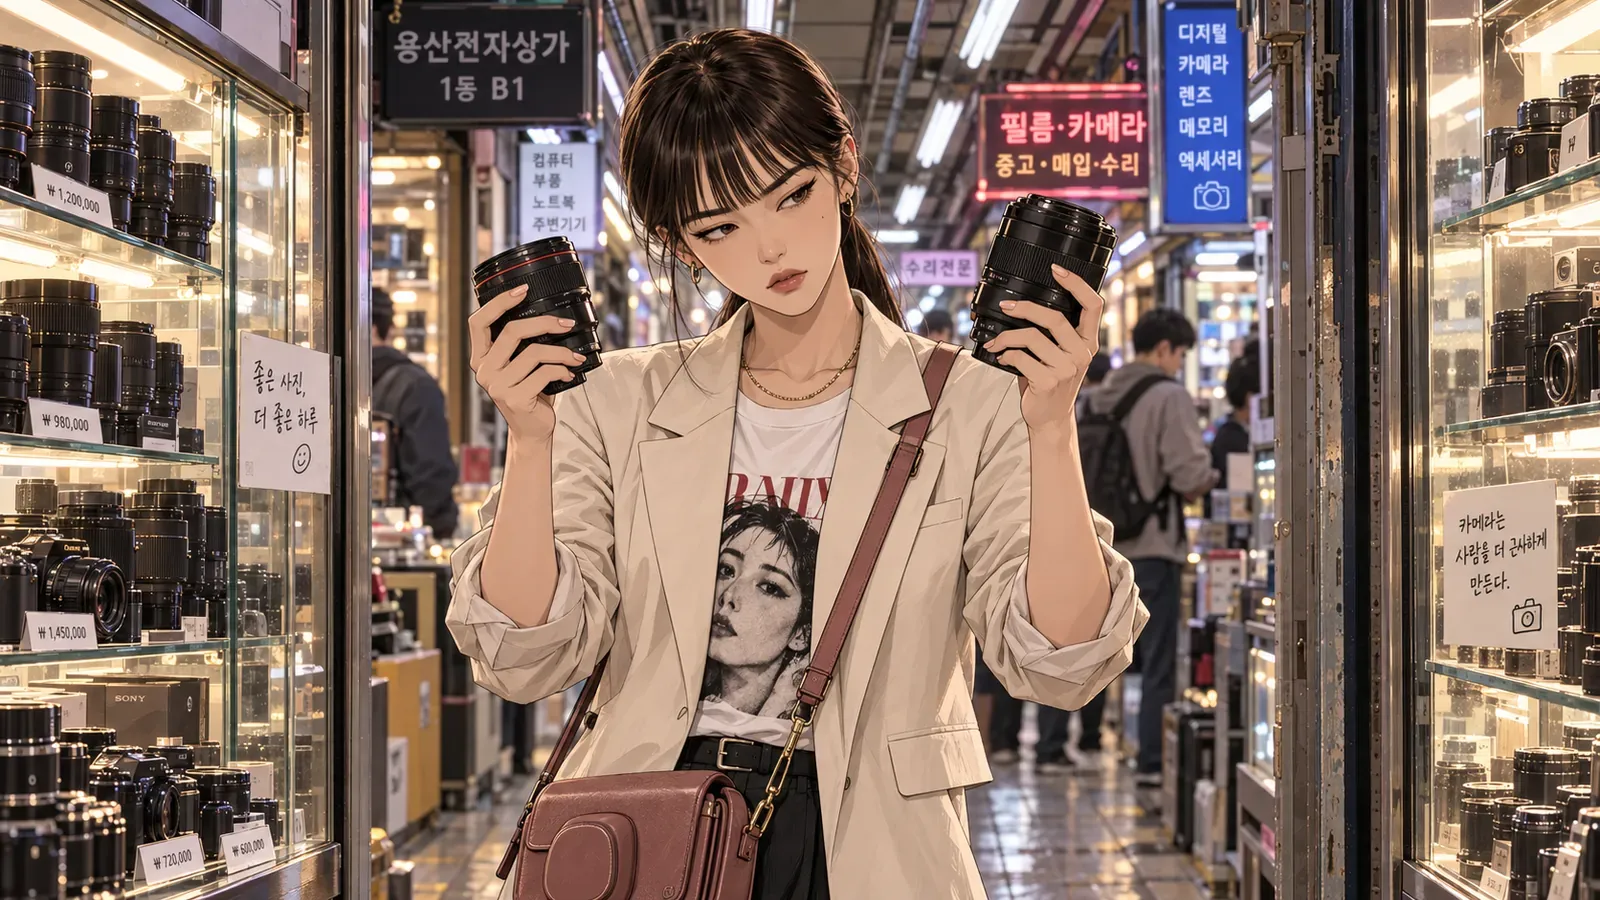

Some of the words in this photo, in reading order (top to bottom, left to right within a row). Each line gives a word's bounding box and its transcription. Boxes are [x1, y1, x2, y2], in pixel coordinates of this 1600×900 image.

[1178, 23, 1227, 45] 디지털
[394, 31, 569, 63] 용산전자상가
[1178, 53, 1230, 76] 카메라
[440, 75, 478, 103] 1동
[491, 76, 523, 101] B1
[1179, 85, 1213, 107] 렌즈
[1179, 115, 1228, 139] 메모리
[532, 152, 573, 169] 컴퓨터
[58, 188, 100, 213] 1,200,000
[532, 195, 575, 210] 노트북
[532, 216, 586, 233] 주변기기
[907, 259, 971, 278] 수리전문
[253, 359, 275, 395] 좋은
[280, 371, 306, 398] 사진,
[53, 414, 89, 432] 980,000
[254, 406, 267, 430] 더
[273, 402, 293, 434] 좋은
[297, 406, 318, 435] 하루
[1458, 510, 1506, 534] 카메라는
[1455, 541, 1490, 566] 사람을
[1494, 541, 1505, 558] 더
[1509, 527, 1547, 558] 근사하게
[1470, 570, 1510, 597] 만든다.
[48, 626, 87, 641] 1,450,000
[114, 694, 146, 703] SONY
[162, 848, 192, 868] 720,000
